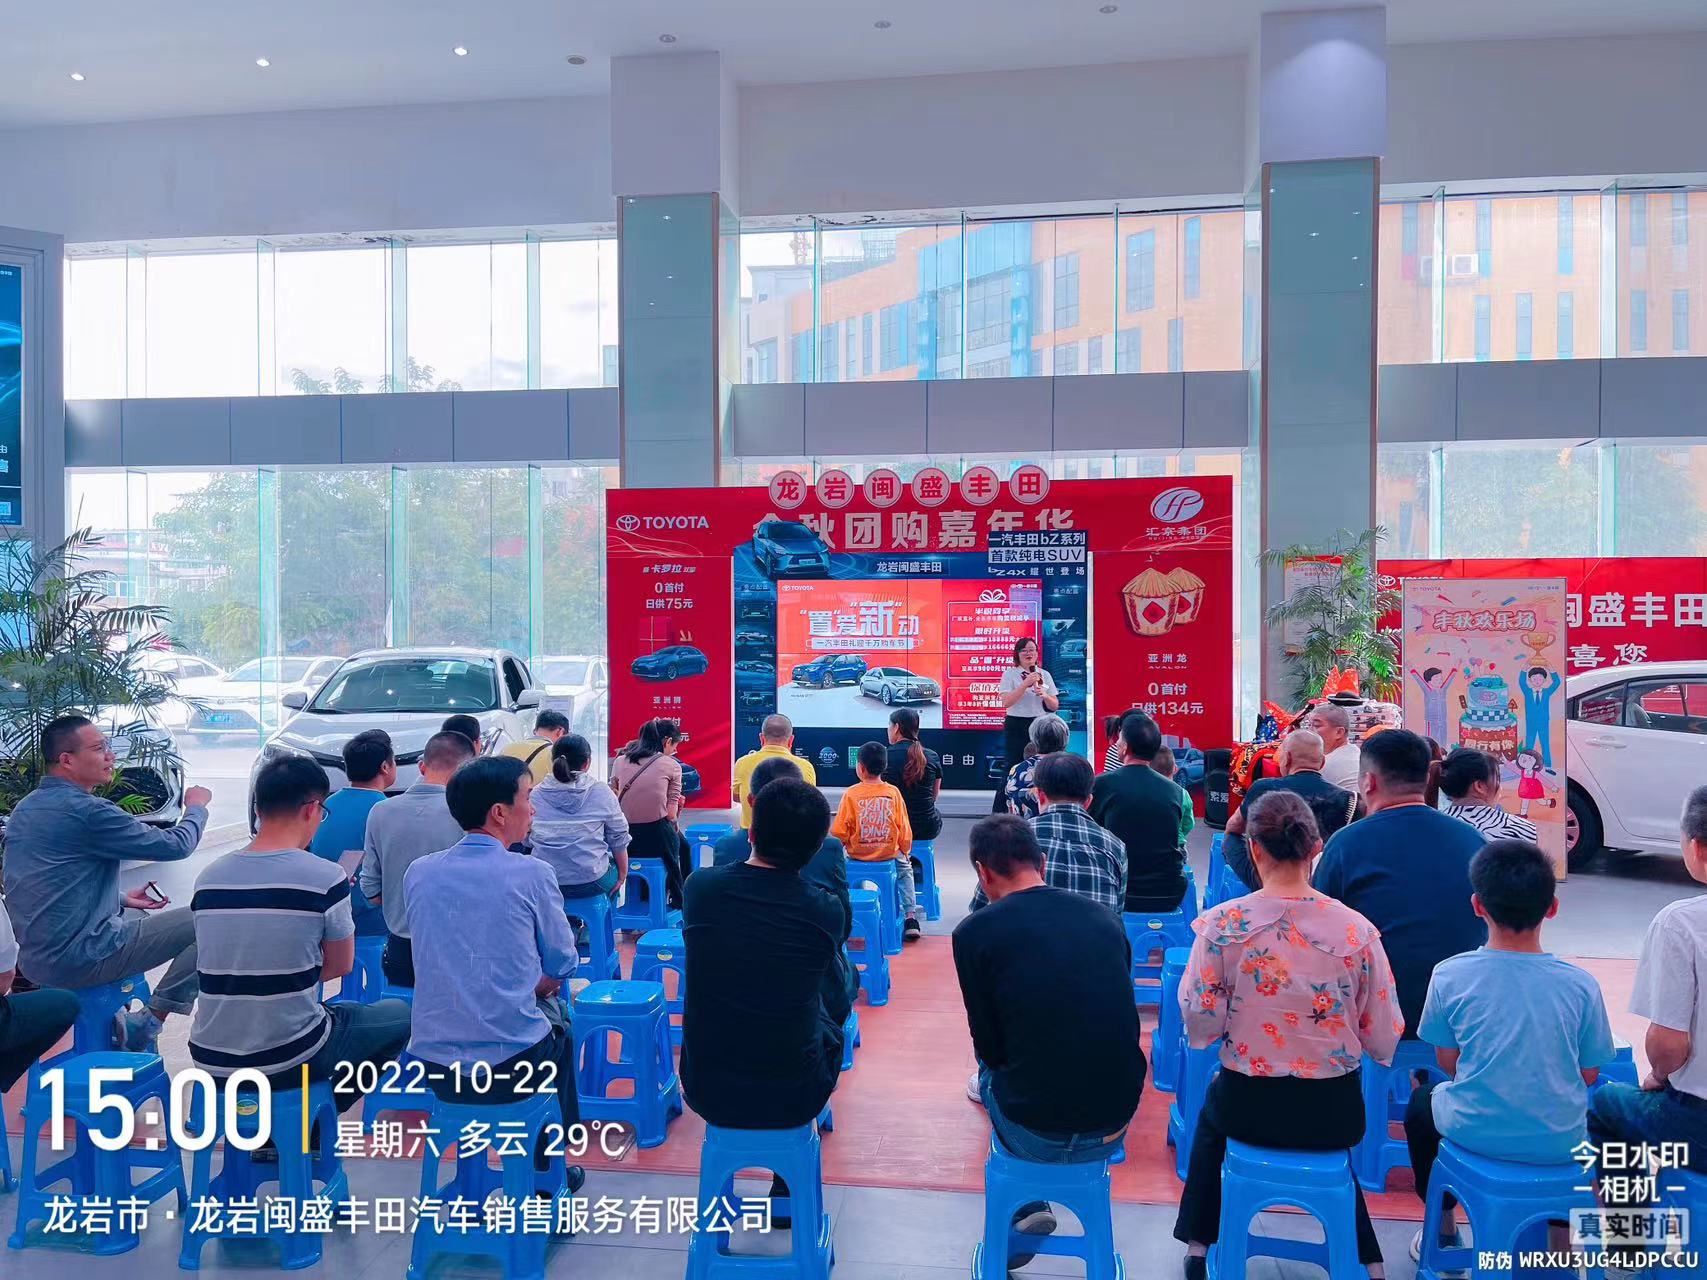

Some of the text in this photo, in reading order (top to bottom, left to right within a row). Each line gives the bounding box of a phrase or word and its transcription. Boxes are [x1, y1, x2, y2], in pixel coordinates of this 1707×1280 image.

[643, 515, 710, 529] TOYOTA
[989, 532, 1086, 545] 一汽丰田bZ系列
[991, 549, 1082, 562] 首款纯电SUV
[876, 561, 942, 573] 龙岩闽盛丰田
[655, 582, 684, 594] 0首付
[646, 598, 693, 609] 日供75元
[1434, 612, 1536, 630] 丰秋欢乐场
[1148, 653, 1187, 663] 亚洲龙
[1147, 682, 1188, 696] 0首付
[943, 753, 975, 766] 自由
